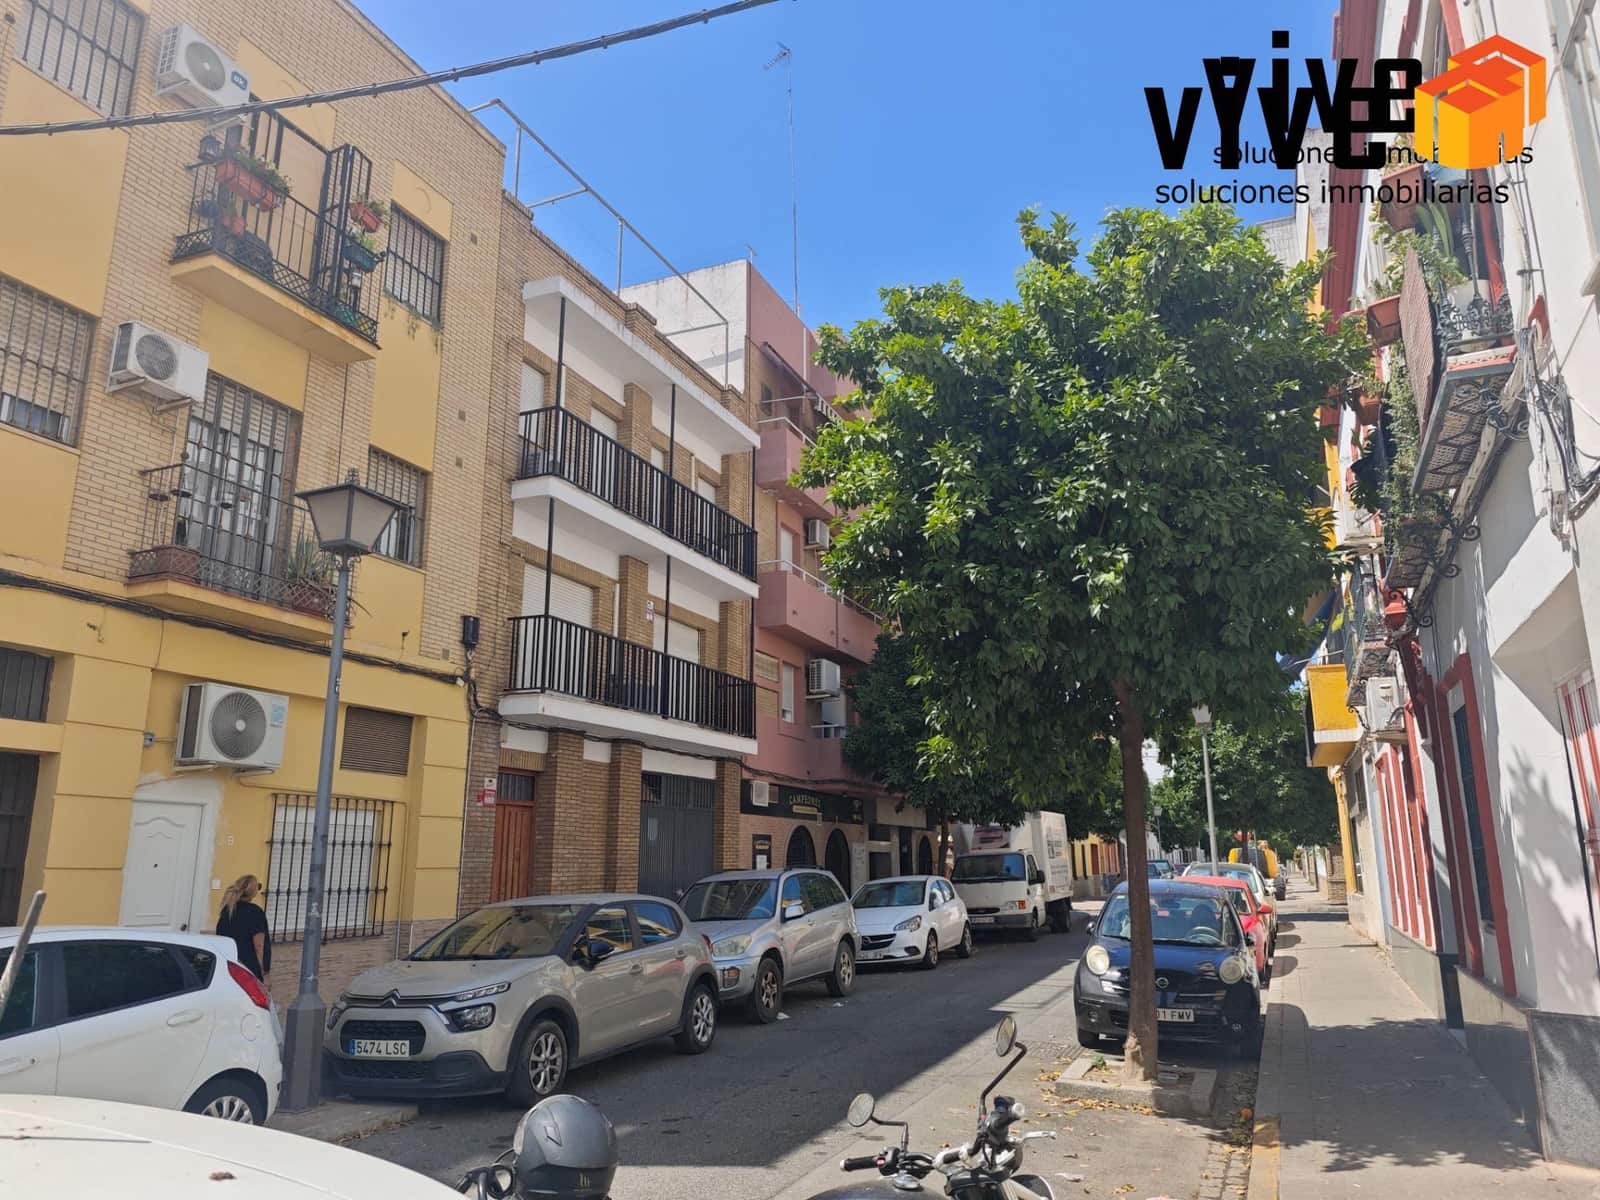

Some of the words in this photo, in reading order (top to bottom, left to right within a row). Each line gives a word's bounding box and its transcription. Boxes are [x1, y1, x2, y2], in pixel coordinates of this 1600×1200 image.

[1171, 1010, 1191, 1020] FMV
[356, 1041, 381, 1054] 5474
[386, 1042, 406, 1055] LSC
